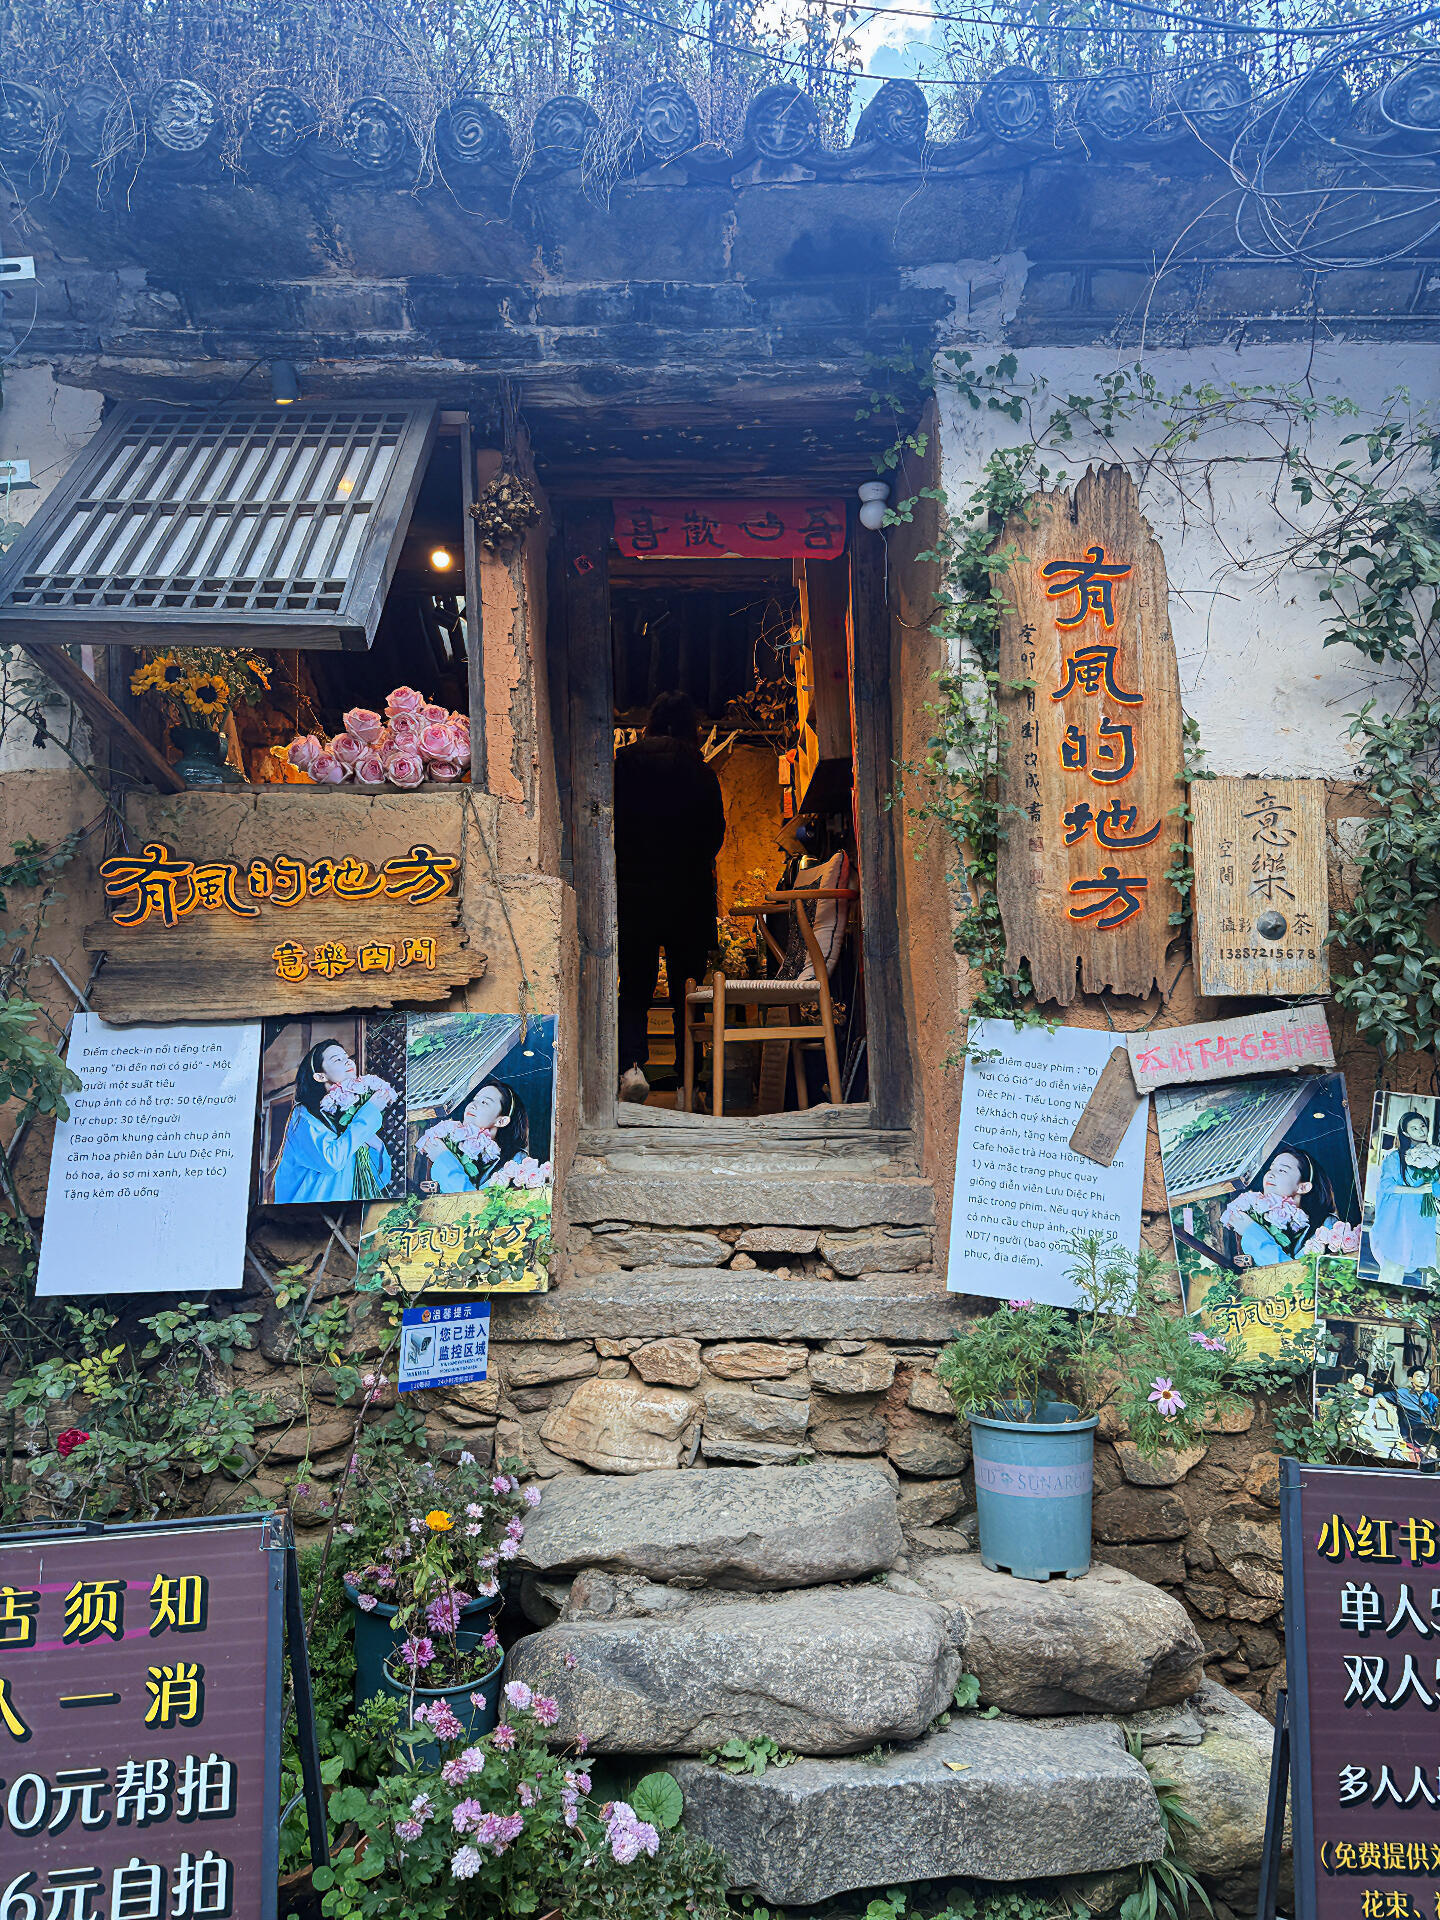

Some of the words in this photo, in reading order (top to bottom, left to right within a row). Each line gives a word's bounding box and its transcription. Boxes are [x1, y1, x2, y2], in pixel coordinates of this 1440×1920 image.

[1041, 545, 1162, 929] 有風的地方
[1242, 791, 1298, 901] 意樂
[1218, 838, 1235, 887] 空間
[100, 843, 458, 928] 有風的地方
[1291, 912, 1315, 936] 茶
[272, 937, 437, 983] 意樂空間
[111, 1046, 152, 1055] check-in
[202, 1044, 222, 1052] trên
[169, 1062, 180, 1070] có
[1025, 1061, 1047, 1071] quay
[1050, 1064, 1074, 1073] phim
[82, 1081, 106, 1091] gười
[1036, 1078, 1046, 1087] do
[1073, 1084, 1093, 1092] viên
[126, 1097, 137, 1106] có
[1001, 1092, 1015, 1101] Phi
[1049, 1098, 1072, 1109] Long
[121, 1116, 132, 1124] 30
[1041, 1114, 1069, 1125] khách
[122, 1132, 153, 1143] khung
[92, 1152, 110, 1160] hoa
[114, 1151, 142, 1162] phiên
[972, 1142, 994, 1151] Cafe
[1039, 1149, 1057, 1159] Hoa
[153, 1168, 180, 1178] xanh,
[972, 1160, 981, 1169] 1)
[1021, 1166, 1045, 1178] trang
[1075, 1173, 1098, 1185] quay
[1023, 1183, 1042, 1194] viên
[1091, 1192, 1105, 1201] Phi
[991, 1198, 1016, 1210] trong
[1019, 1201, 1046, 1212] phim.
[1092, 1209, 1121, 1222] khách
[967, 1212, 978, 1222] có
[981, 1215, 998, 1224] nhu
[1107, 1230, 1118, 1240] 50
[966, 1230, 990, 1242] NDT/
[1024, 1237, 1046, 1249] (bao
[440, 1323, 487, 1342] 您已进入
[438, 1341, 486, 1361] 监控区域
[1317, 1514, 1437, 1562] 小红书
[1343, 1653, 1440, 1706] 双人
[1339, 1764, 1440, 1805] 多人人
